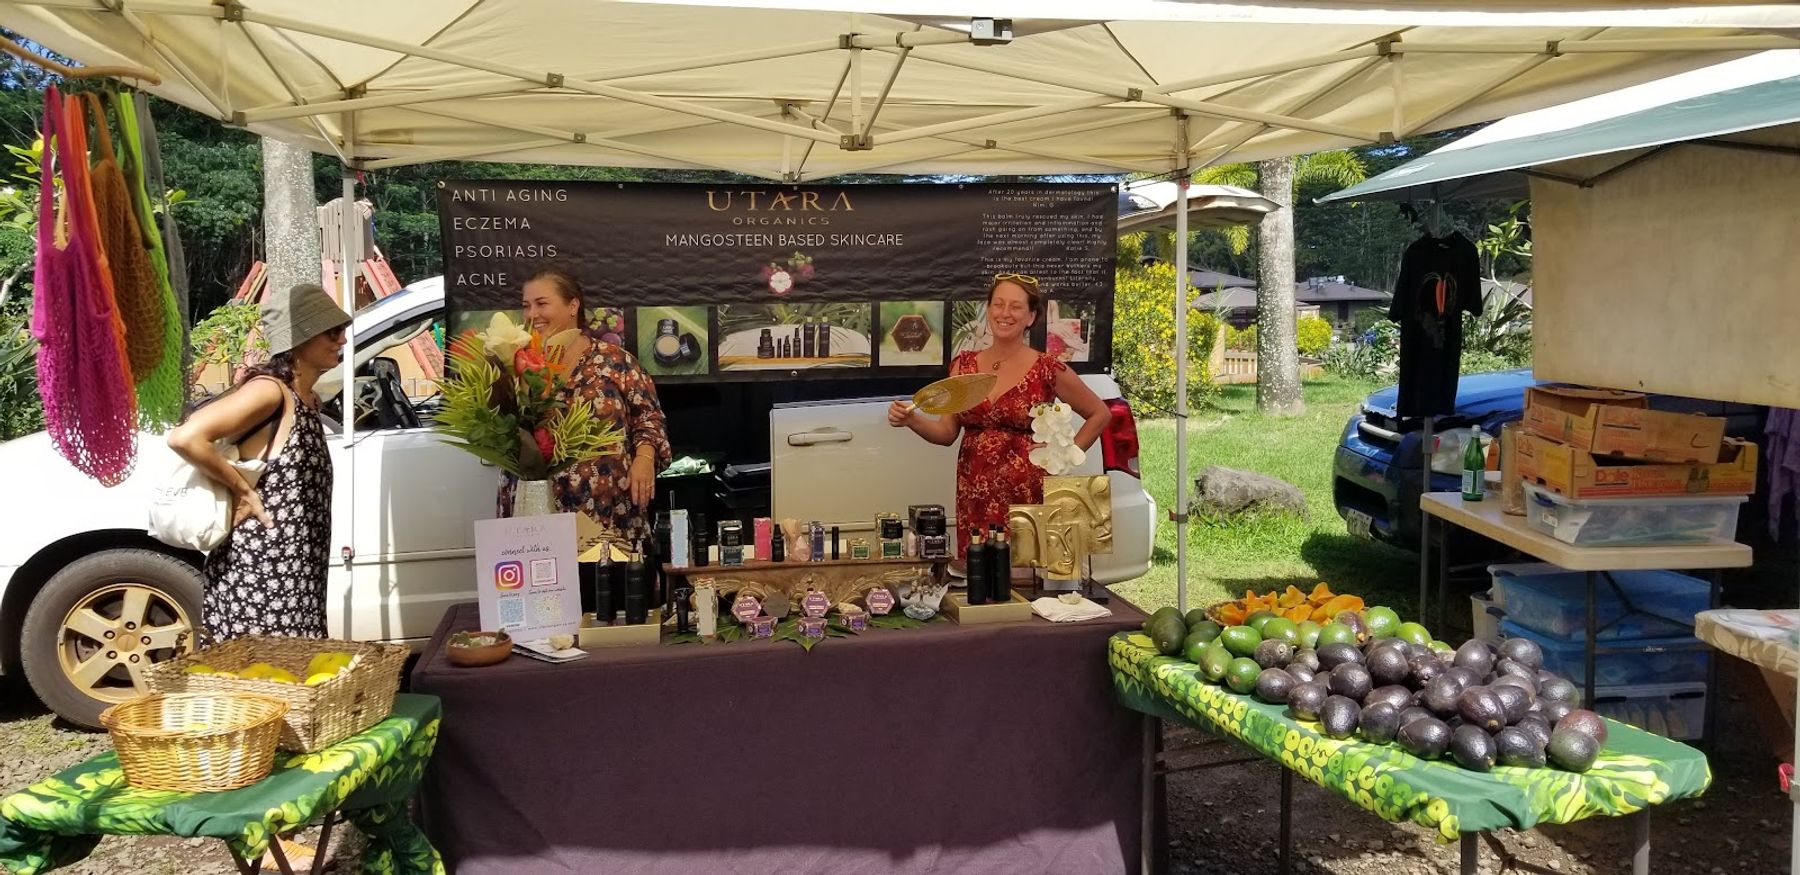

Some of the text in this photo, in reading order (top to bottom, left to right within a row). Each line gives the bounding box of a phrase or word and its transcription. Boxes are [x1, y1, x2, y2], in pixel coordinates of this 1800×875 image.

[452, 189, 568, 202] ANTI AGING
[706, 191, 855, 211] UTARA
[453, 217, 531, 230] ECZEMA
[733, 217, 830, 226] ORGANICS
[665, 233, 903, 247] MANGOSTEEN BASED SKINCARE
[455, 245, 558, 259] PSORIASIS
[456, 273, 507, 286] ACNE
[1596, 470, 1630, 482] Dole
[526, 542, 541, 553] with
